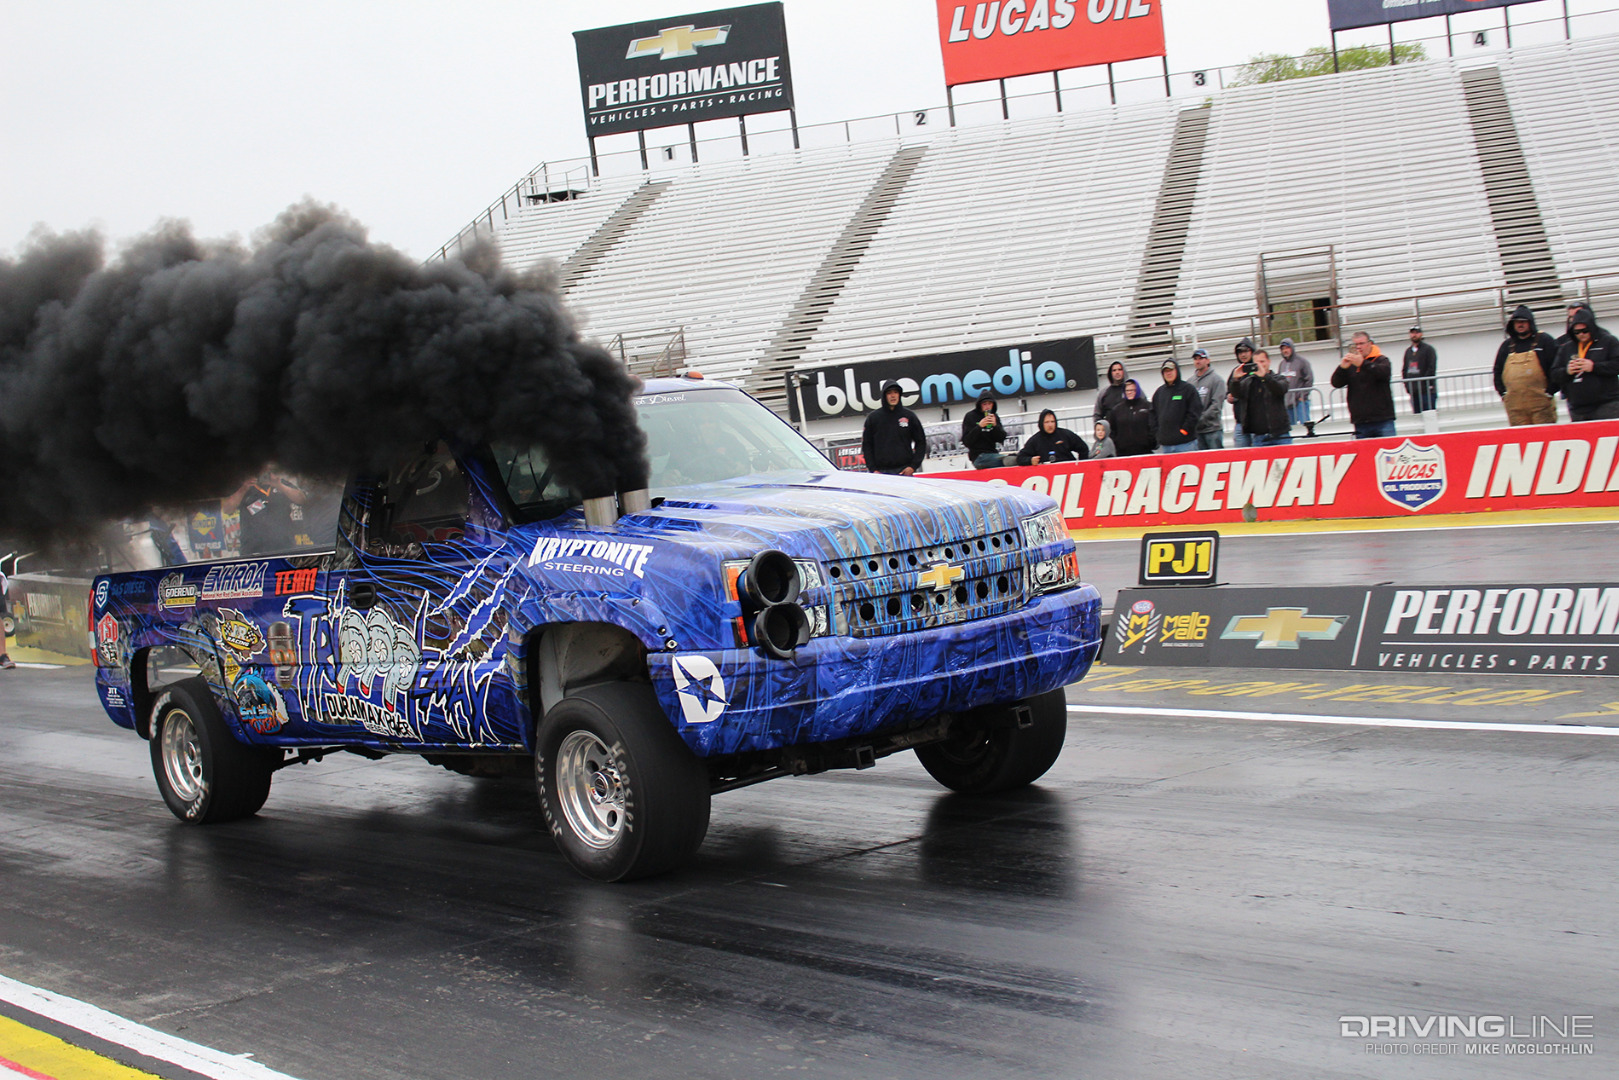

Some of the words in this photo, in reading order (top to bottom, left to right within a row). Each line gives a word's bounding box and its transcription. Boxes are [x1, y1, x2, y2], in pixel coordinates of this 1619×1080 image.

[948, 0, 1076, 43] LUCAS
[1475, 32, 1486, 46] 4
[588, 56, 781, 109] PERFORMANCE
[1195, 73, 1206, 86] 3
[591, 107, 656, 125] VEHICLES
[672, 98, 714, 112] PARTS
[730, 88, 783, 104] RACING
[916, 112, 926, 126] 2
[664, 147, 673, 160] 1
[1388, 463, 1438, 480] LUCAS
[1465, 436, 1619, 498] INDI
[1095, 453, 1357, 517] RACEWAY
[1384, 484, 1399, 492] OIL
[1399, 482, 1441, 491] PRODUCTS
[527, 537, 654, 579] KRYPTONITE
[544, 562, 625, 577] STEERING
[1148, 541, 1211, 574] PJ1
[275, 567, 318, 596] TEAM
[1383, 588, 1619, 635] PERFORM
[226, 636, 250, 647] RACING
[1378, 653, 1499, 669] VEHICLES
[1527, 655, 1609, 671] PARTS
[325, 693, 387, 730] DURAMAX
